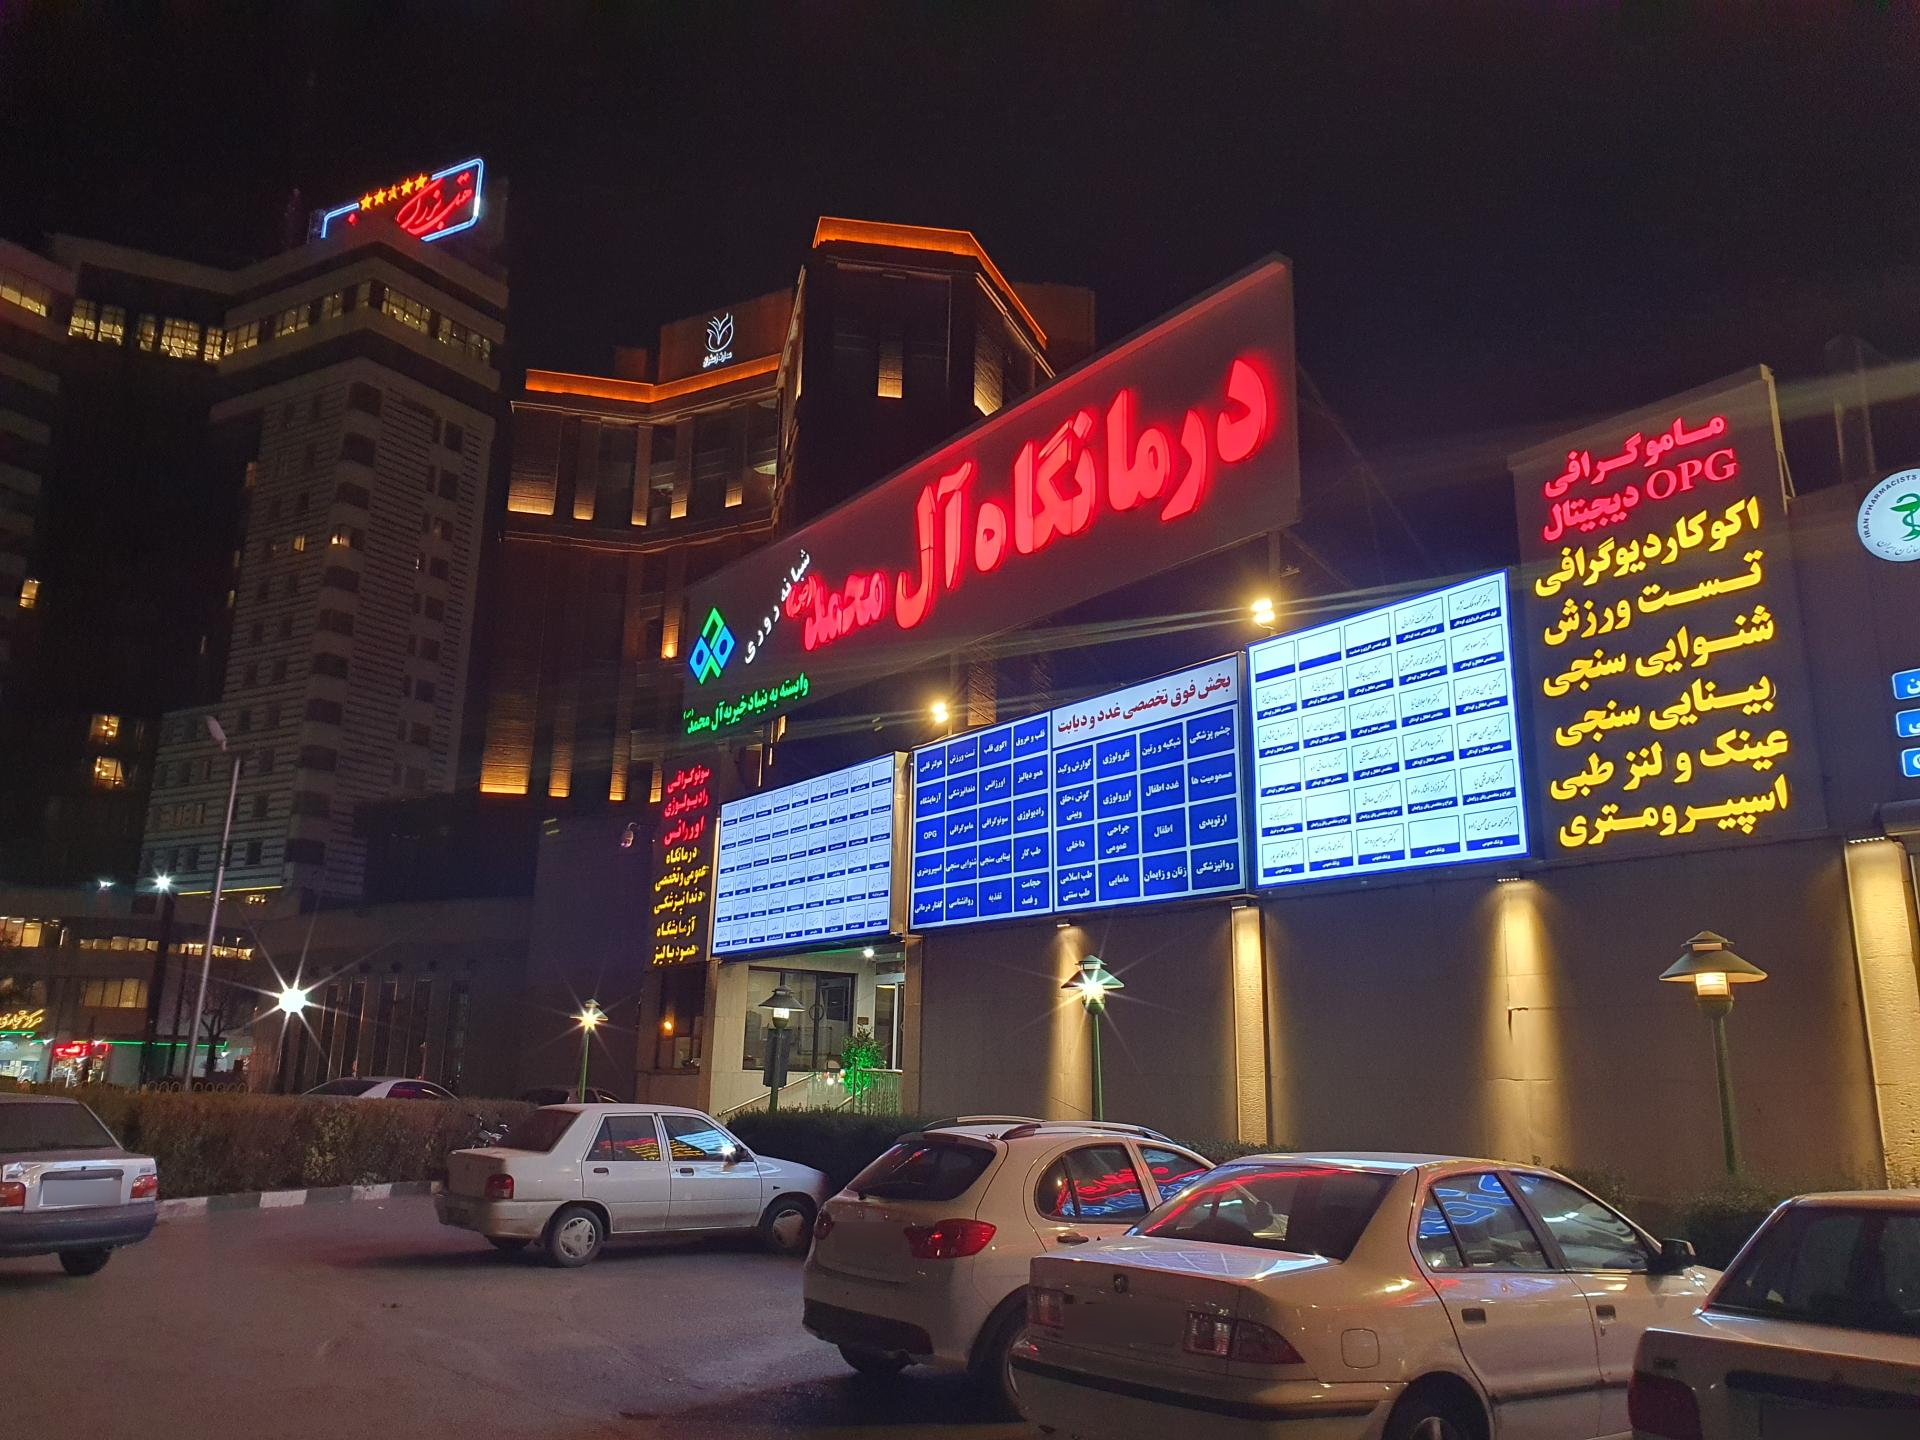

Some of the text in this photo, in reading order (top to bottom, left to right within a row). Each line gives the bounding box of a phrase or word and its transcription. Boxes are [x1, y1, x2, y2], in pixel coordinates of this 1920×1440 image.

[974, 358, 1267, 573] درمانگاه
[1544, 415, 1726, 497] ماموگرافی
[1646, 448, 1738, 500] OPG
[1543, 485, 1640, 541] دیجیتال
[1863, 474, 1918, 539] IRAN PHARMACISTS
[895, 460, 974, 631] آل
[1535, 495, 1760, 597] اکوکاردیوگرافی
[781, 549, 811, 603] شبانه
[805, 571, 887, 651] محمد
[1544, 549, 1764, 646] تست ورزش
[1543, 605, 1775, 697] شنوایی سنجی
[748, 688, 769, 713] بنیاد
[769, 686, 779, 708] به
[779, 672, 809, 704] وابسته
[711, 701, 726, 732] آل
[724, 695, 747, 726] خیریه
[1057, 673, 1231, 735] بخش فوق تخصصی غدد و دیابت
[1555, 675, 1775, 747] بینایی سنجی
[1189, 731, 1214, 745] پزشکی
[1190, 770, 1232, 785] مسمومیت ها
[1551, 728, 1789, 800] عینک و لنز طبی
[667, 765, 710, 794] سونوگرافی
[1145, 783, 1165, 797] اطفال
[664, 788, 709, 818] رادیولوژی
[1102, 789, 1132, 805] اورولوژی
[1559, 773, 1789, 848] اسپیرومتری
[1016, 807, 1044, 822] رادیولوژی
[923, 830, 937, 840] OPG
[1106, 824, 1130, 837] جراحی
[1153, 823, 1174, 838] اطفال
[666, 846, 698, 865] درمانگاه
[1066, 840, 1086, 852] داخلی
[1108, 874, 1130, 887] مامایی
[1143, 869, 1166, 883] زایمان
[1195, 858, 1234, 875] روانپزشکی
[654, 887, 705, 915] دندانپزشکی
[656, 915, 697, 940] آزمایشگاه
